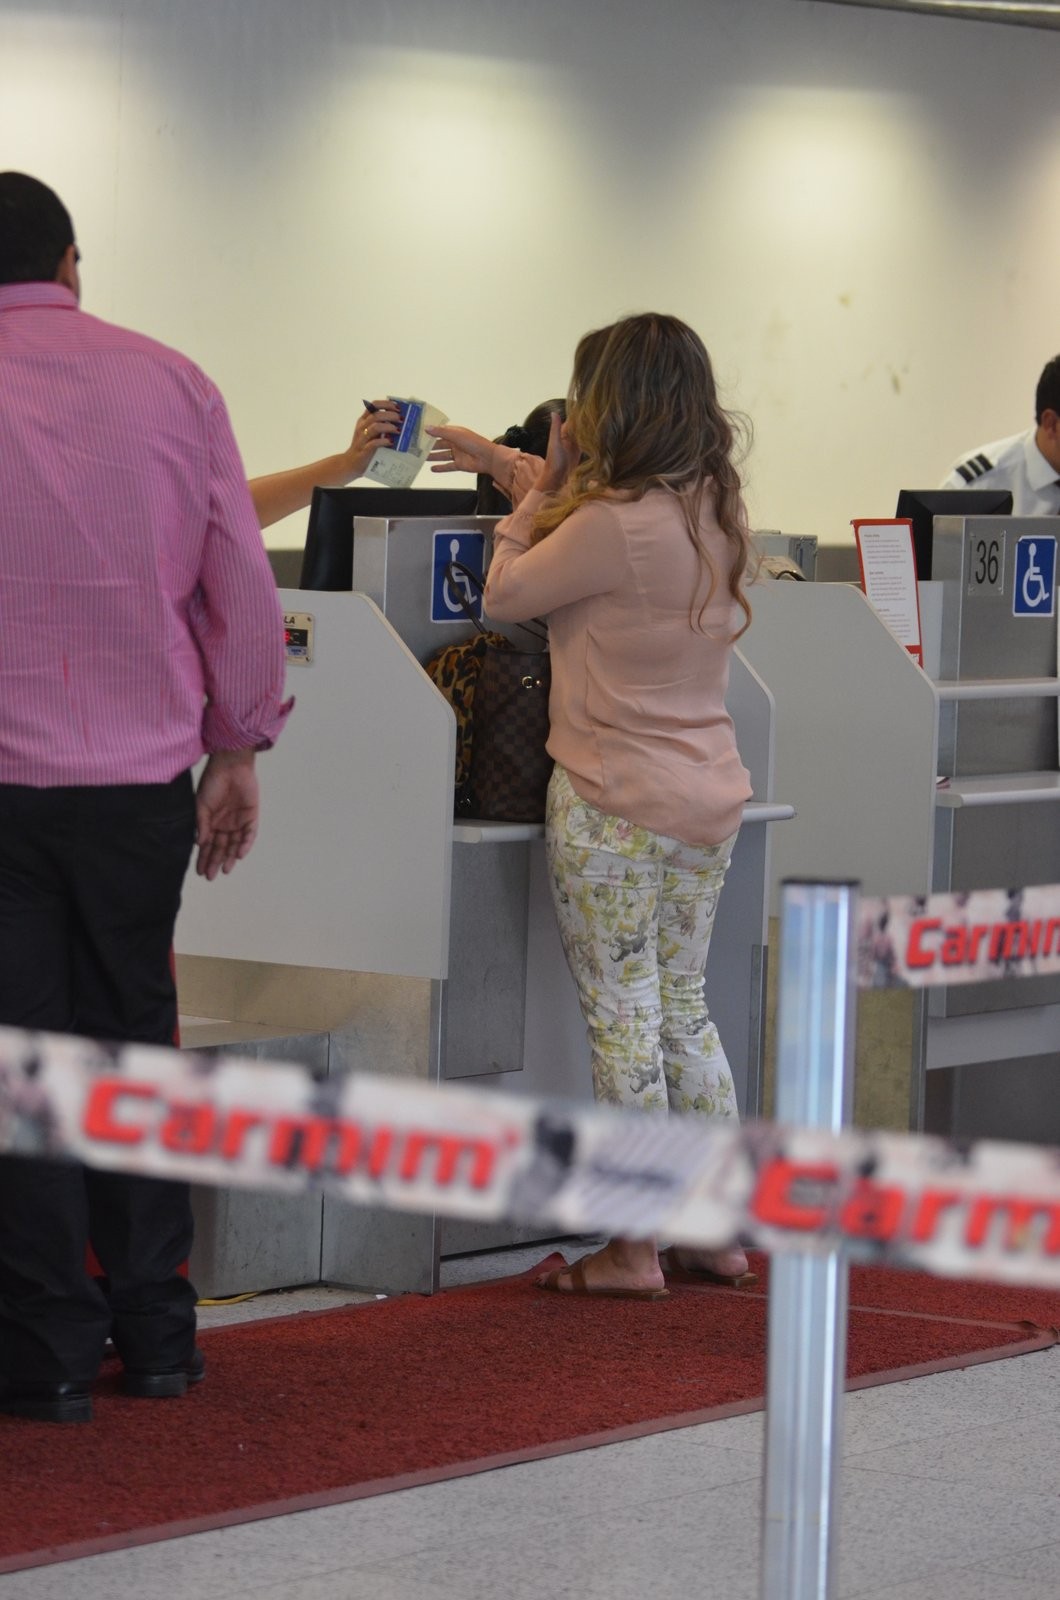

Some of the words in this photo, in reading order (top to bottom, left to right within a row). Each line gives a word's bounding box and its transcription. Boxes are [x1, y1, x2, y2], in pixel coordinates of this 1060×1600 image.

[975, 540, 999, 585] 36
[82, 1077, 498, 1191] Carmim
[749, 1158, 1060, 1256] Carm
